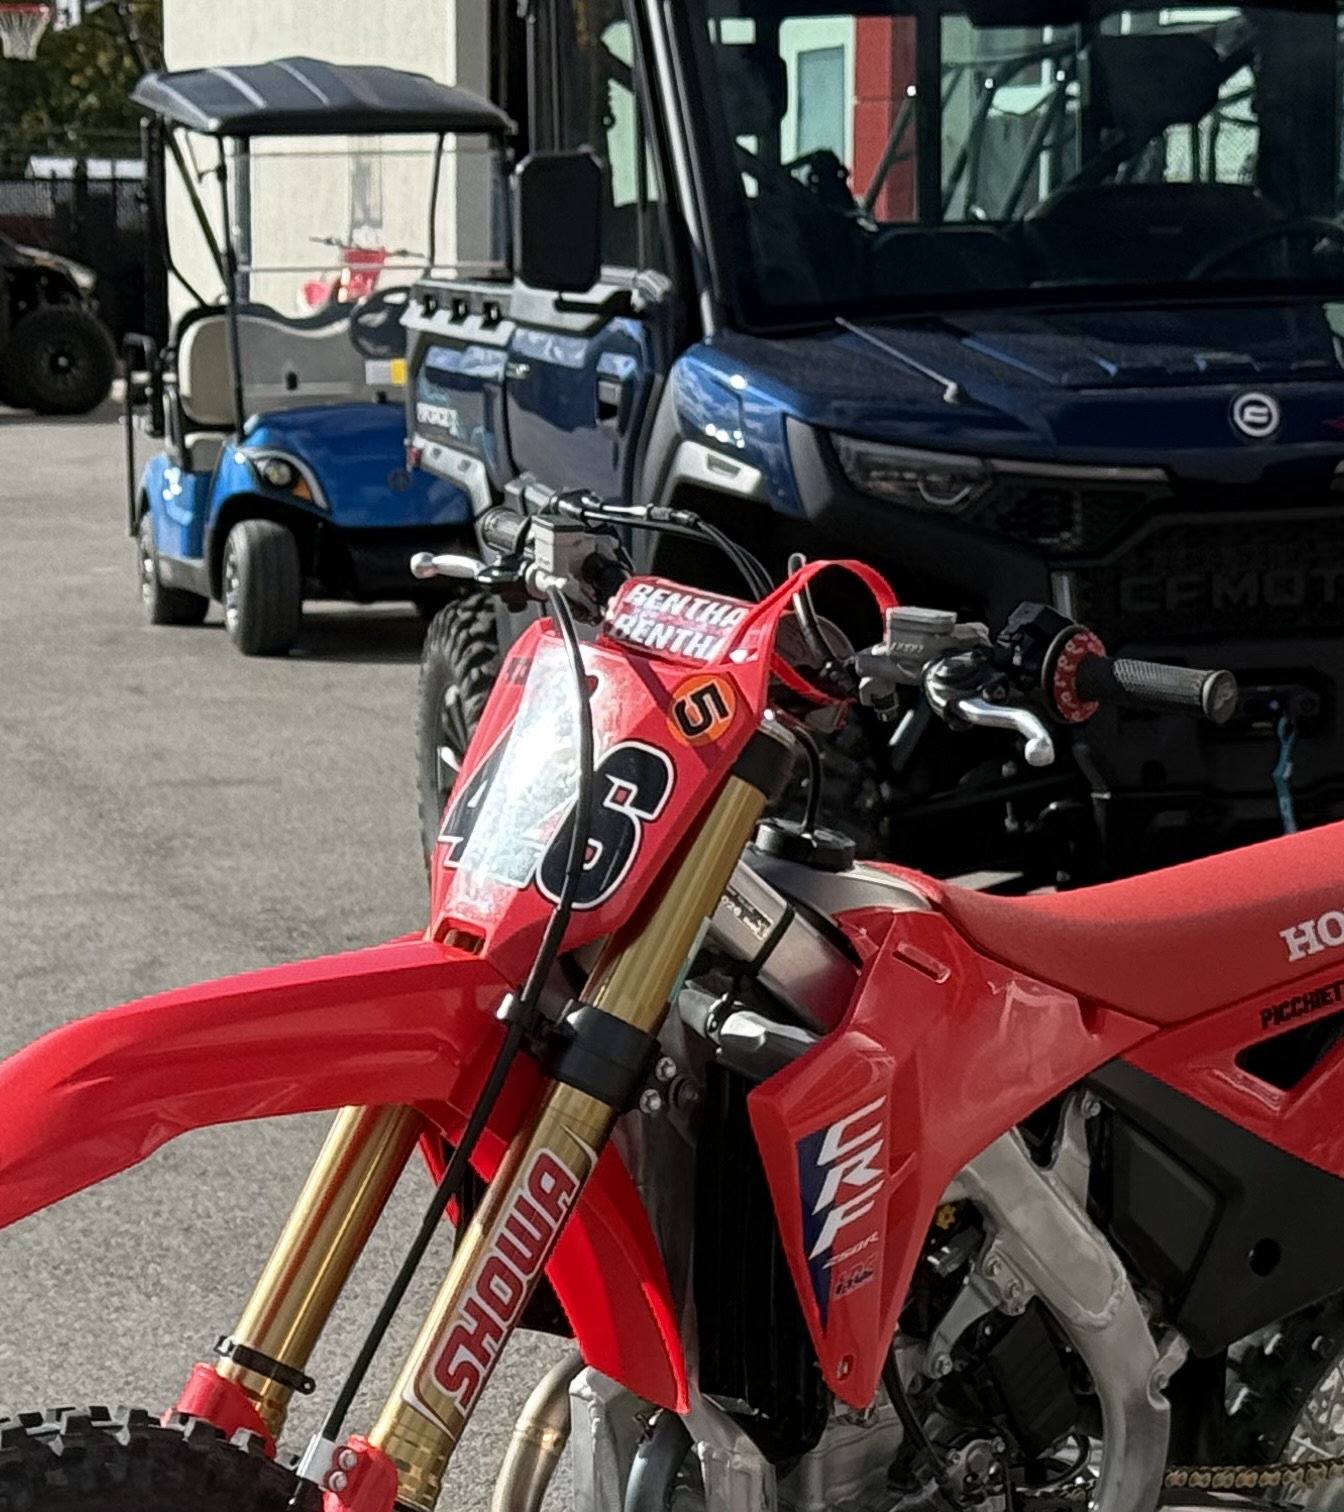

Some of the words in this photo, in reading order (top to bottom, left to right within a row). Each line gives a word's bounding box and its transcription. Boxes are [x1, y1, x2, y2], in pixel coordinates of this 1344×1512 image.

[624, 583, 750, 628] RENTHA
[672, 681, 730, 738] 5
[808, 1094, 887, 1261] CRF
[432, 1149, 579, 1416] SHOWA
